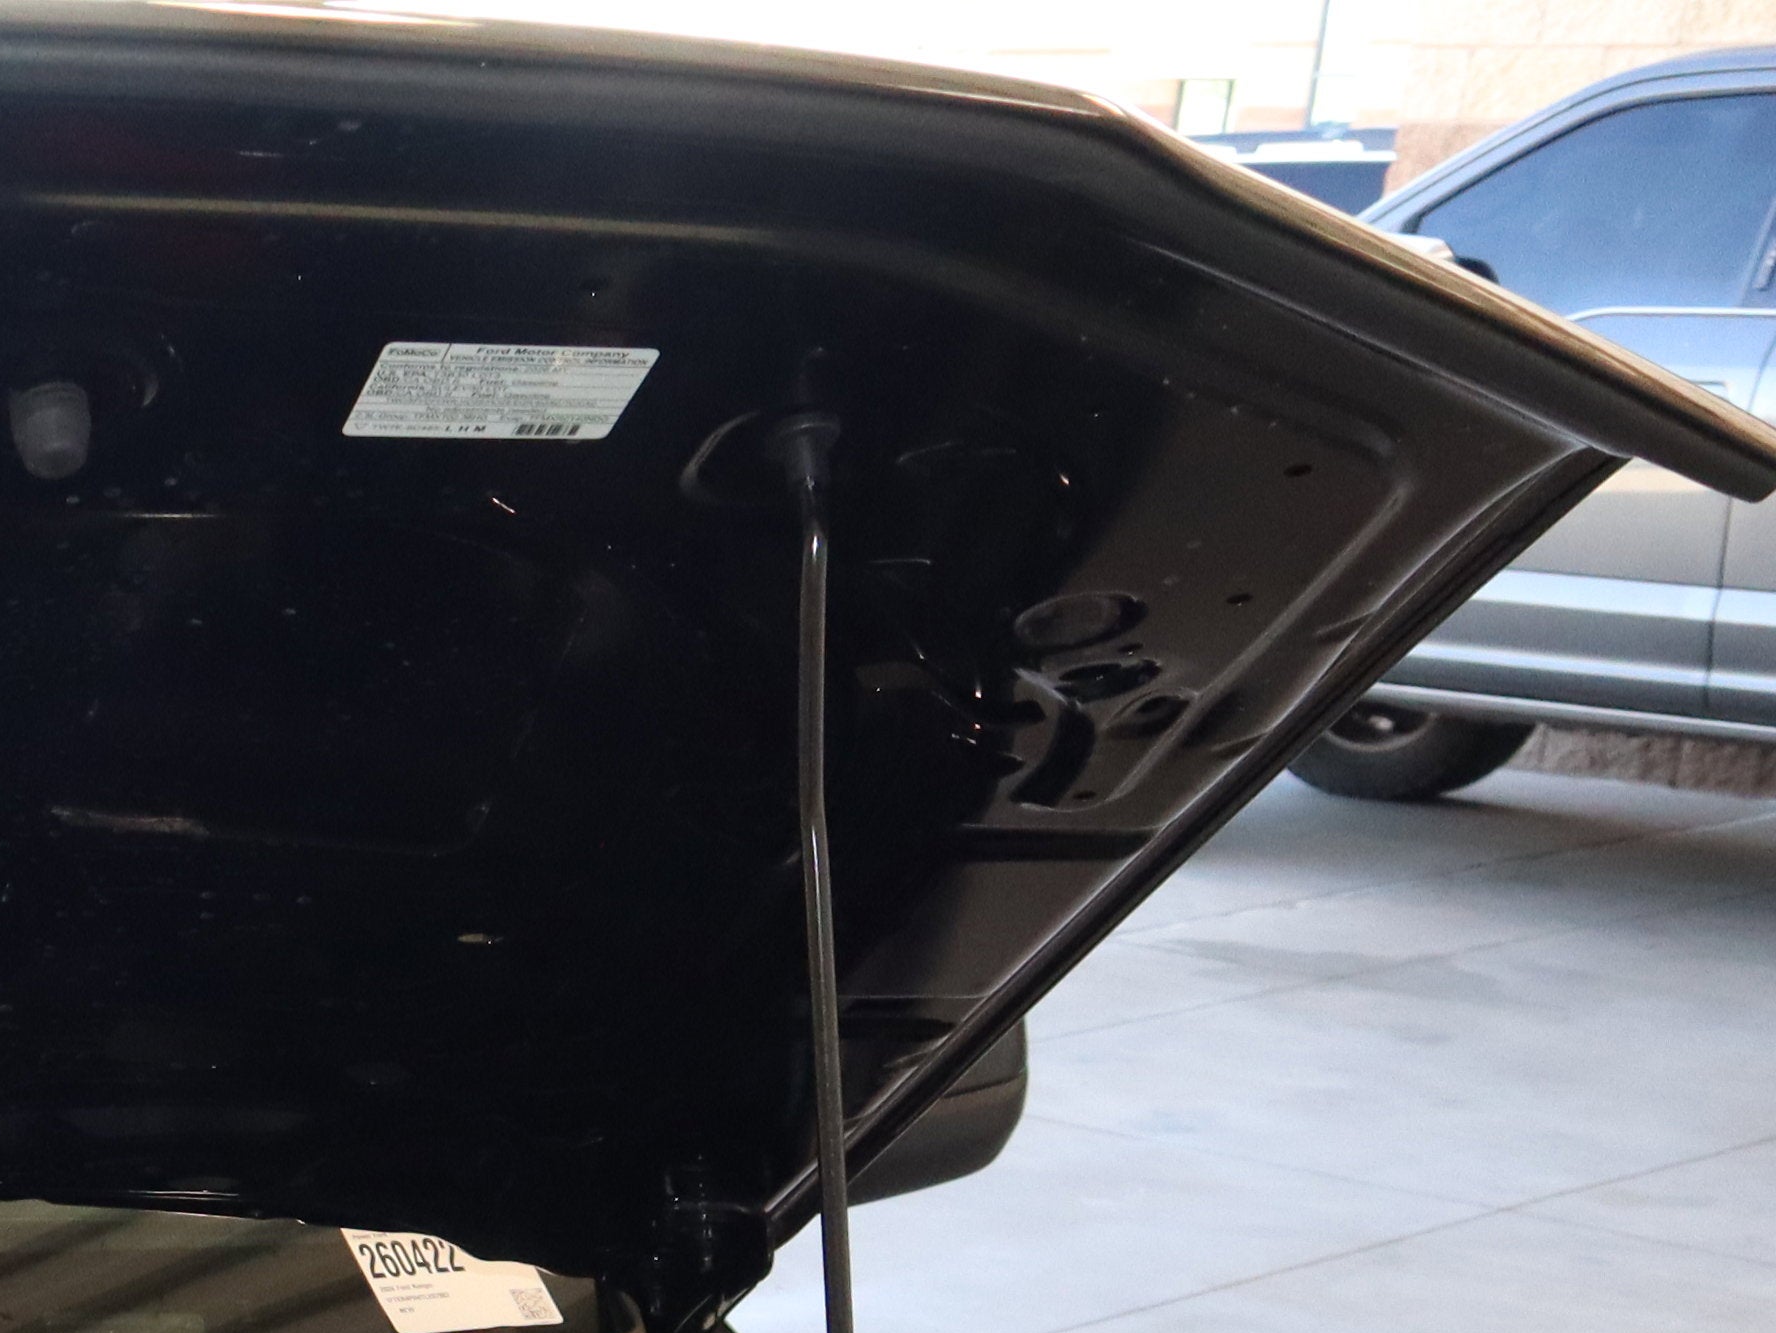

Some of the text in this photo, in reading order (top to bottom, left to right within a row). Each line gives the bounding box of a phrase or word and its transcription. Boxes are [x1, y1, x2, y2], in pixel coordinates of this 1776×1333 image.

[477, 347, 629, 359] Ford Motor Company
[359, 1237, 465, 1279] 260422
